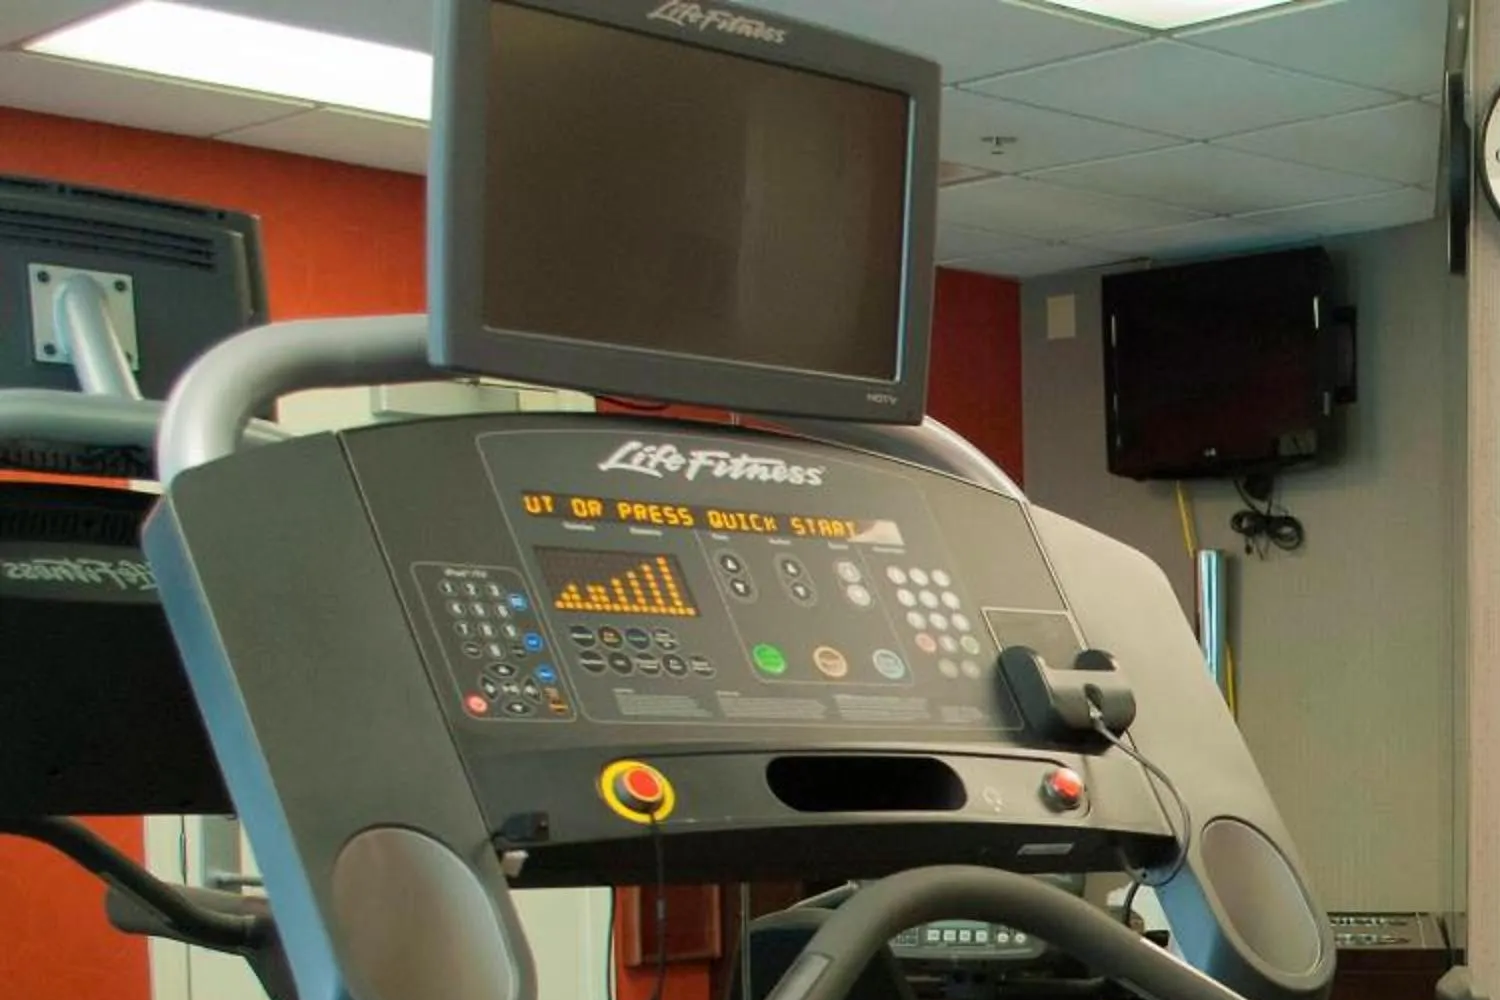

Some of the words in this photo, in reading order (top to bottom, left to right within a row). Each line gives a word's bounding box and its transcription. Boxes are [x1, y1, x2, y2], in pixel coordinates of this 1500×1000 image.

[571, 498, 603, 518] OR
[616, 501, 694, 527] PRESS
[707, 510, 778, 532] QUICK
[789, 516, 857, 538] START
